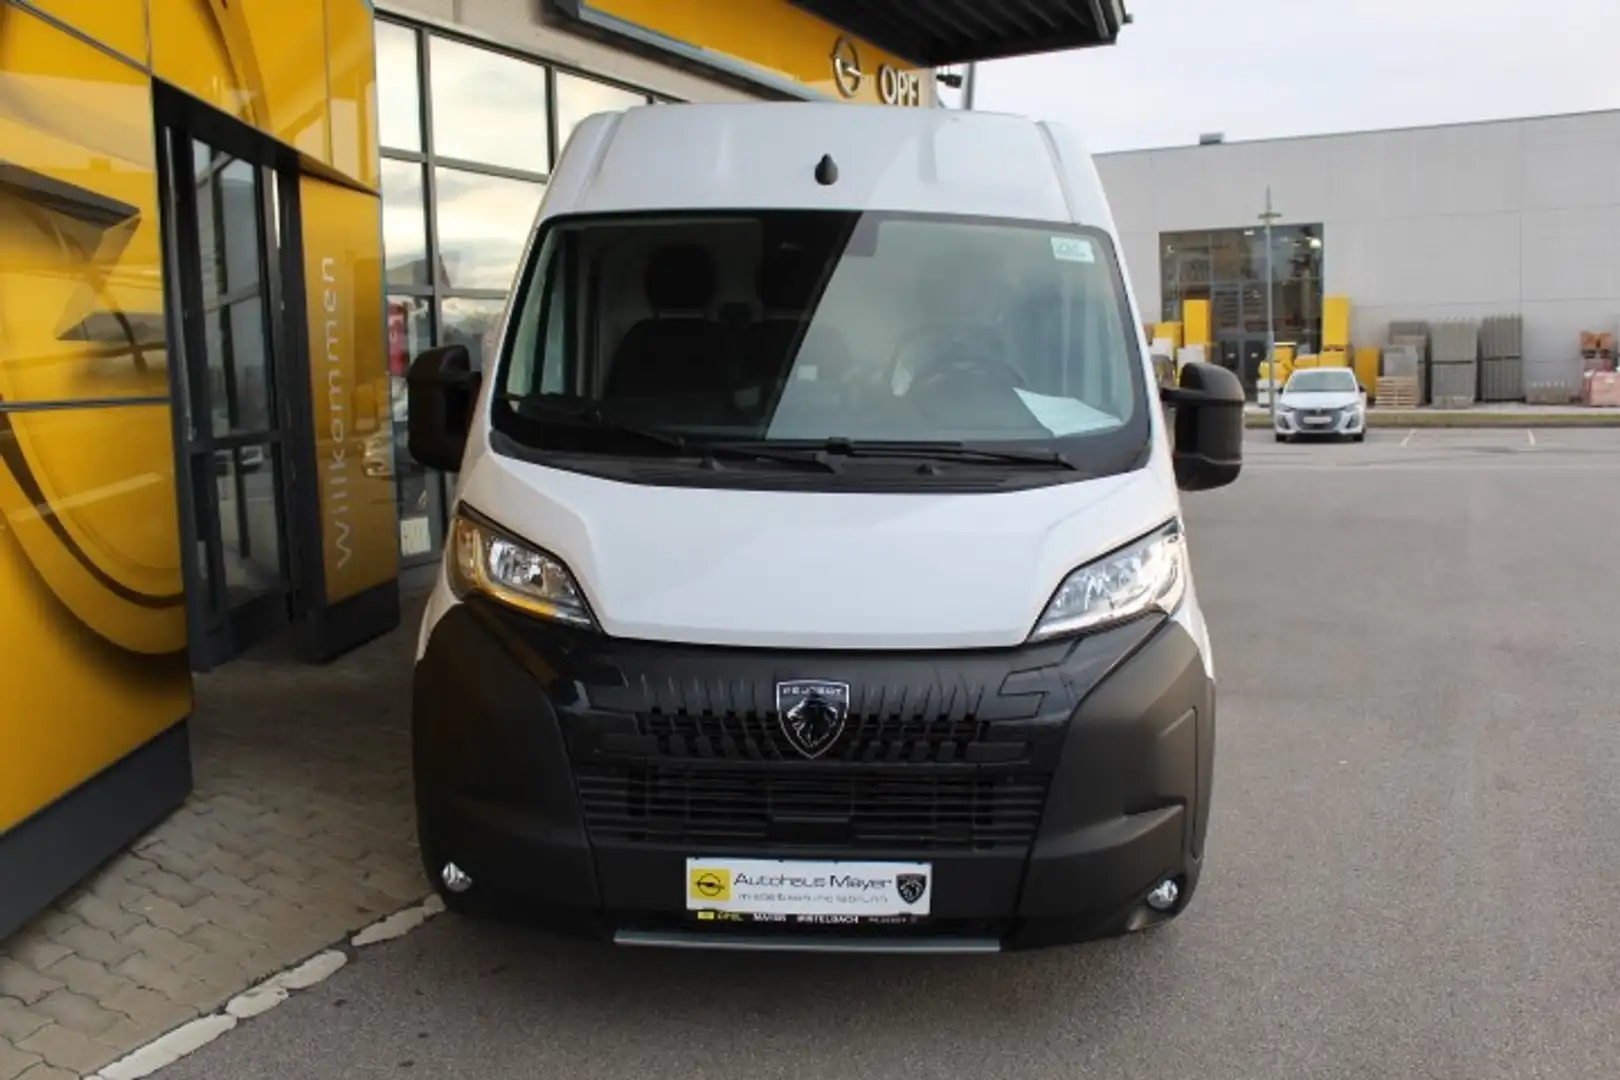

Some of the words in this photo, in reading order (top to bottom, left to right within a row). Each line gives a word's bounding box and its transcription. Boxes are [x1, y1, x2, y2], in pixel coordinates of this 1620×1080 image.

[321, 257, 352, 570] willkommen
[733, 872, 825, 888] Autohaus
[829, 874, 892, 891] Mayer
